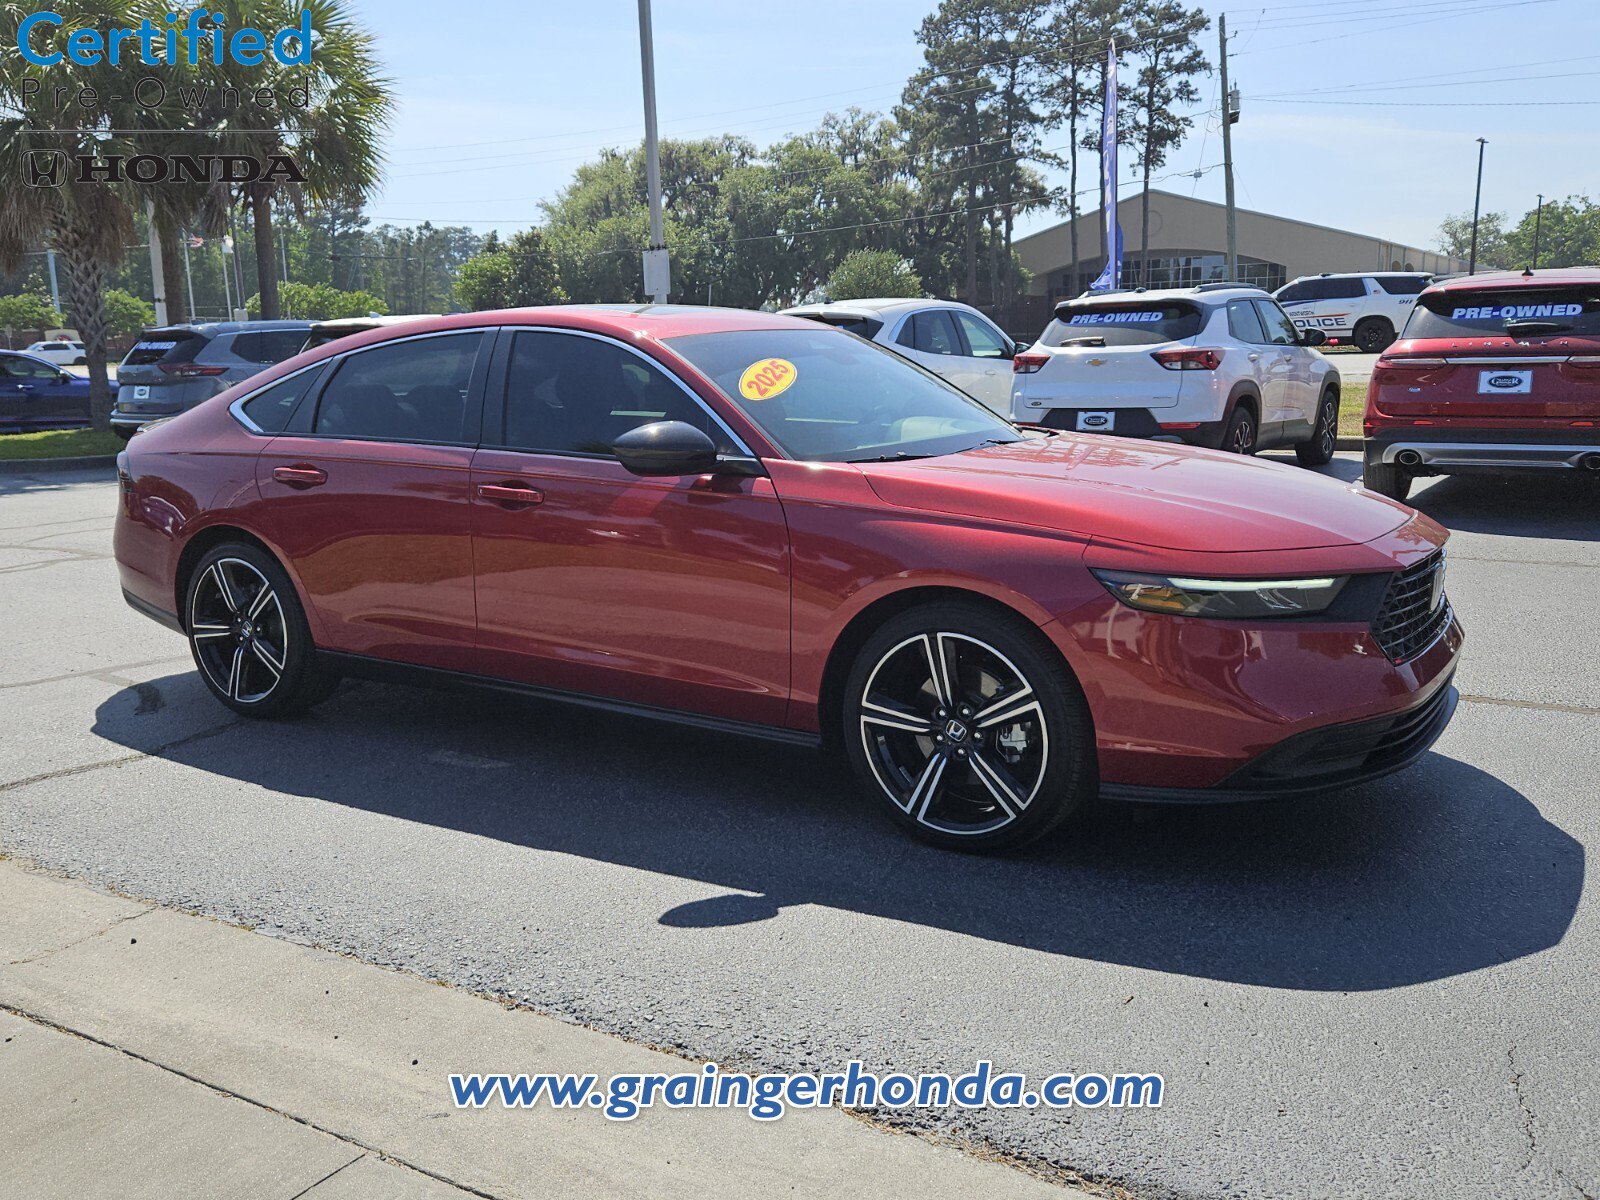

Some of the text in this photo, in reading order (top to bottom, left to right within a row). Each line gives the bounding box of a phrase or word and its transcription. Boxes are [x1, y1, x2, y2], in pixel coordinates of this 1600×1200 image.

[1069, 311, 1164, 325] PRE-OWNED
[1452, 303, 1583, 320] PRE-OWNED
[1293, 317, 1347, 328] OLICE
[746, 360, 789, 397] 2025
